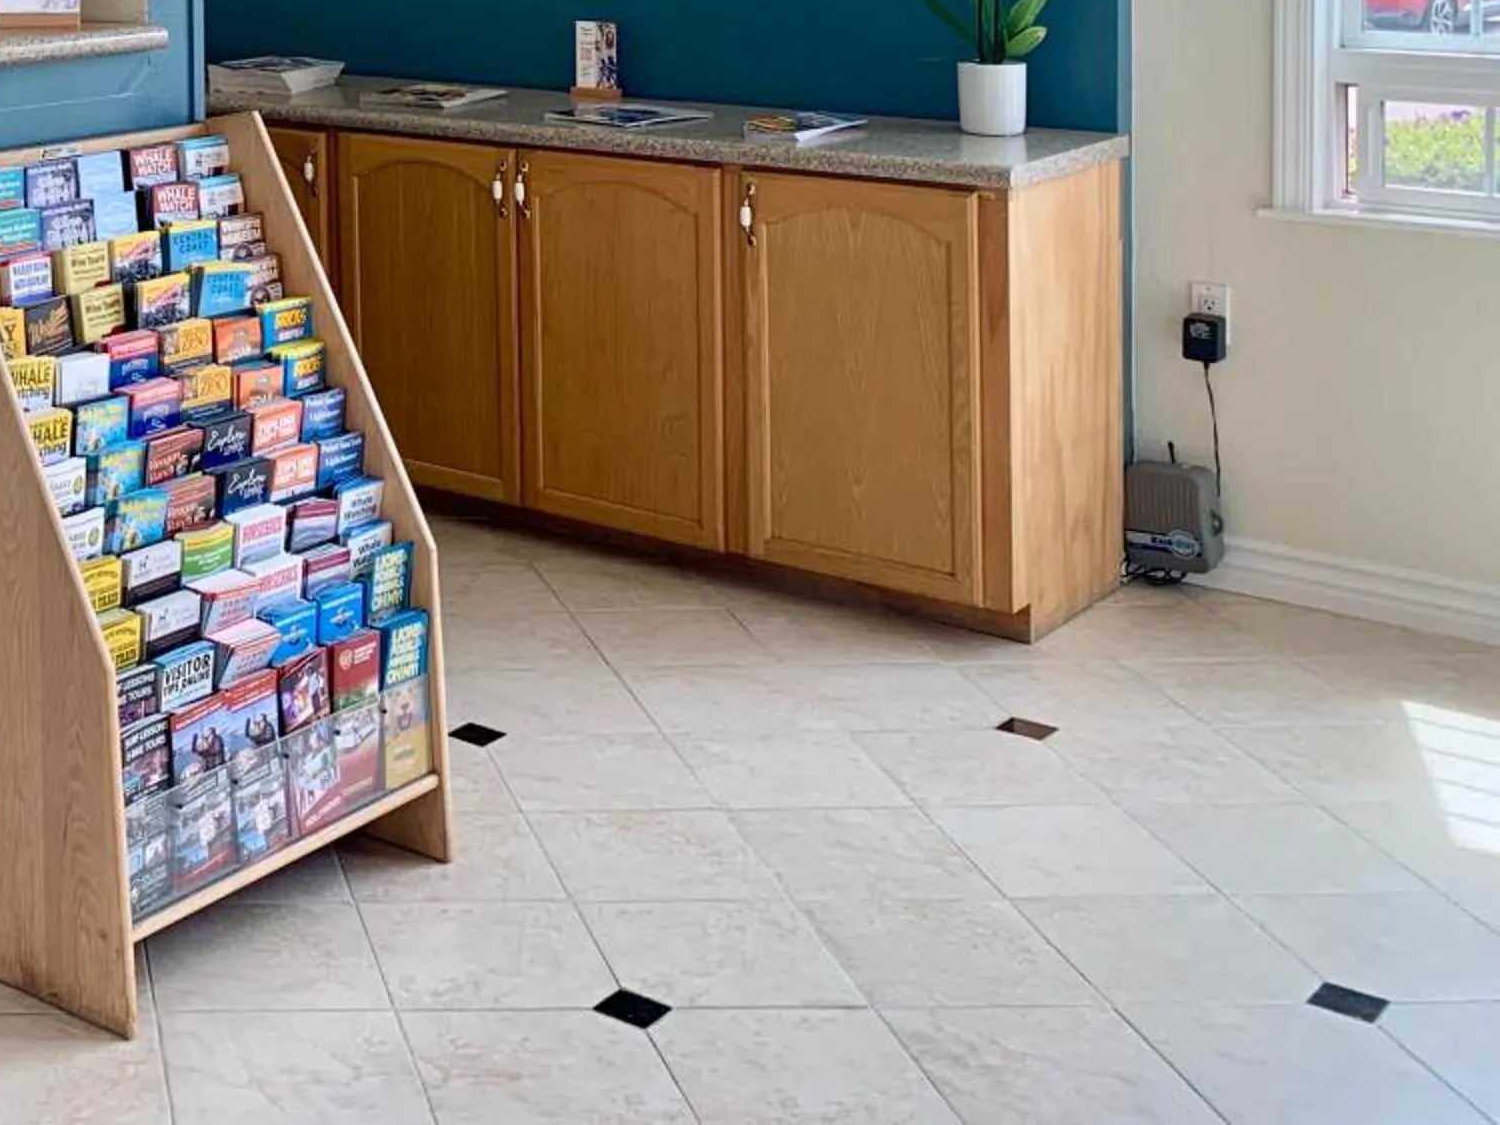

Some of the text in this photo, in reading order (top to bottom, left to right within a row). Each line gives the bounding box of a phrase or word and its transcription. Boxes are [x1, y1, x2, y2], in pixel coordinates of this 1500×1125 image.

[133, 146, 172, 167] WHALE
[138, 160, 171, 177] WATCH
[157, 184, 196, 203] WHALE
[159, 197, 195, 213] WATCH
[33, 420, 68, 443] HALE
[164, 654, 211, 685] VISITOR
